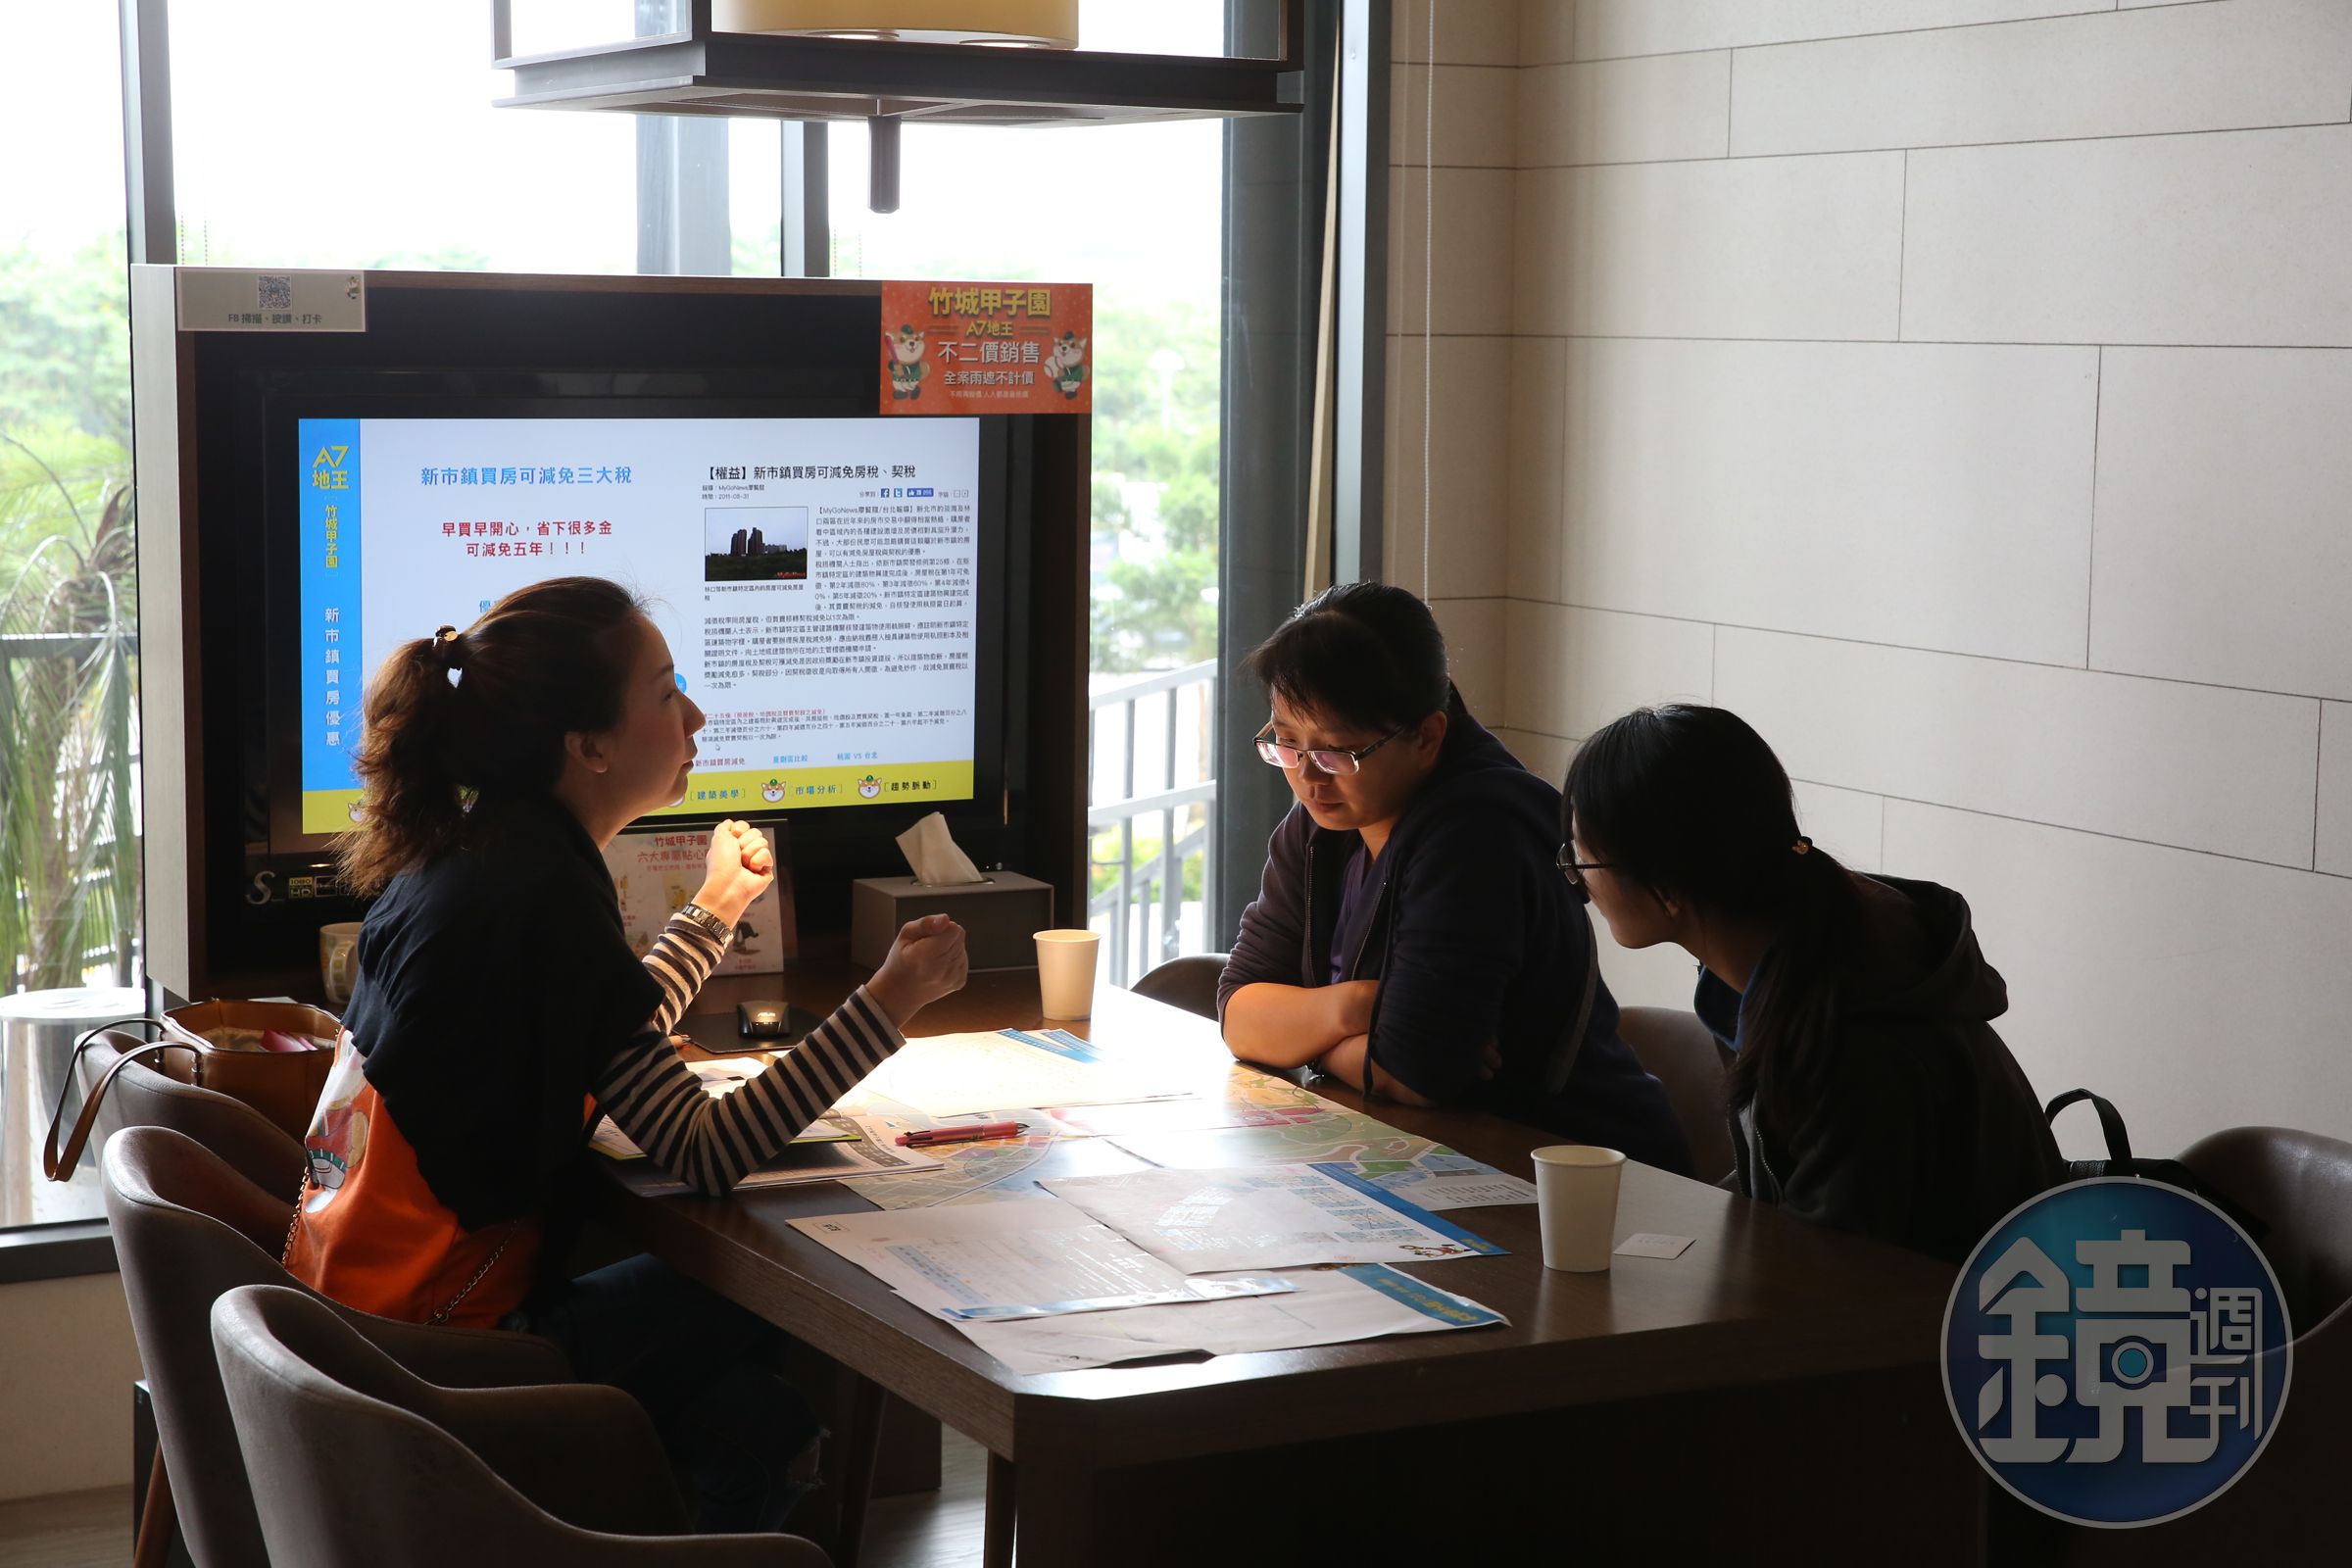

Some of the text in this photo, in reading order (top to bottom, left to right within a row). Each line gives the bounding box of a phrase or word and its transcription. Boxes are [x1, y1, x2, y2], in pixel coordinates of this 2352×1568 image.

[928, 287, 1051, 317] 竹城甲子園
[228, 314, 239, 322] FB
[965, 320, 1013, 337] A7地王
[938, 341, 1040, 365] 不二價銷售
[944, 371, 1035, 385] 全案雨遮不計價
[313, 446, 349, 468] A7
[313, 469, 350, 490] 地王
[421, 466, 631, 485] 新市鎮買房可減免三大稅
[324, 505, 338, 568] 竹城甲子園
[442, 520, 612, 537] 早買早開心，省下很多金
[466, 542, 586, 557] 可減免五年！！！
[325, 608, 340, 746] 新市鎮買房優惠
